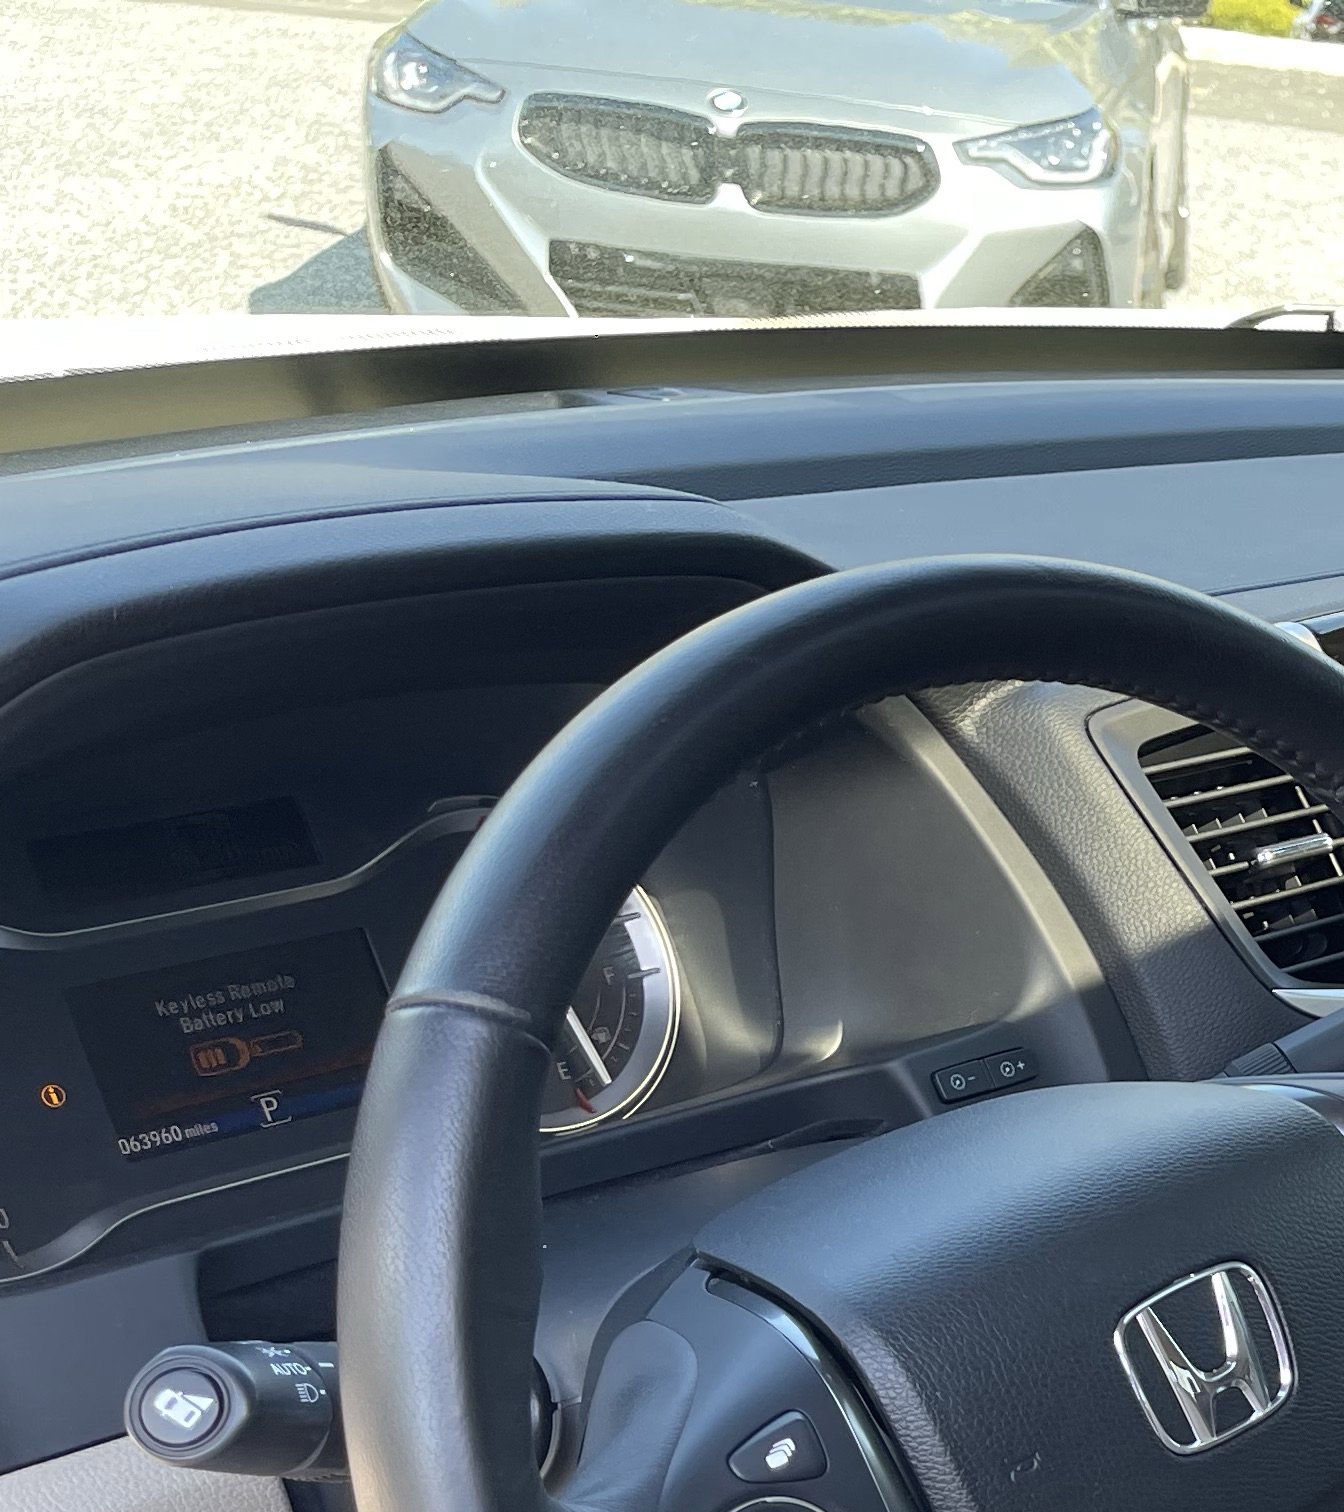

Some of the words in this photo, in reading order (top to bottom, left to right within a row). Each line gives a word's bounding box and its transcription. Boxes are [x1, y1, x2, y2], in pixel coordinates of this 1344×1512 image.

[154, 987, 226, 1017] Keyless
[227, 973, 297, 1000] Remote
[179, 1005, 246, 1034] Battery
[248, 998, 285, 1019] Low
[557, 1060, 571, 1081] E
[260, 1097, 279, 1123] P
[118, 1124, 183, 1156] 063960
[184, 1120, 219, 1139] miles
[270, 1362, 307, 1376] AUTO
